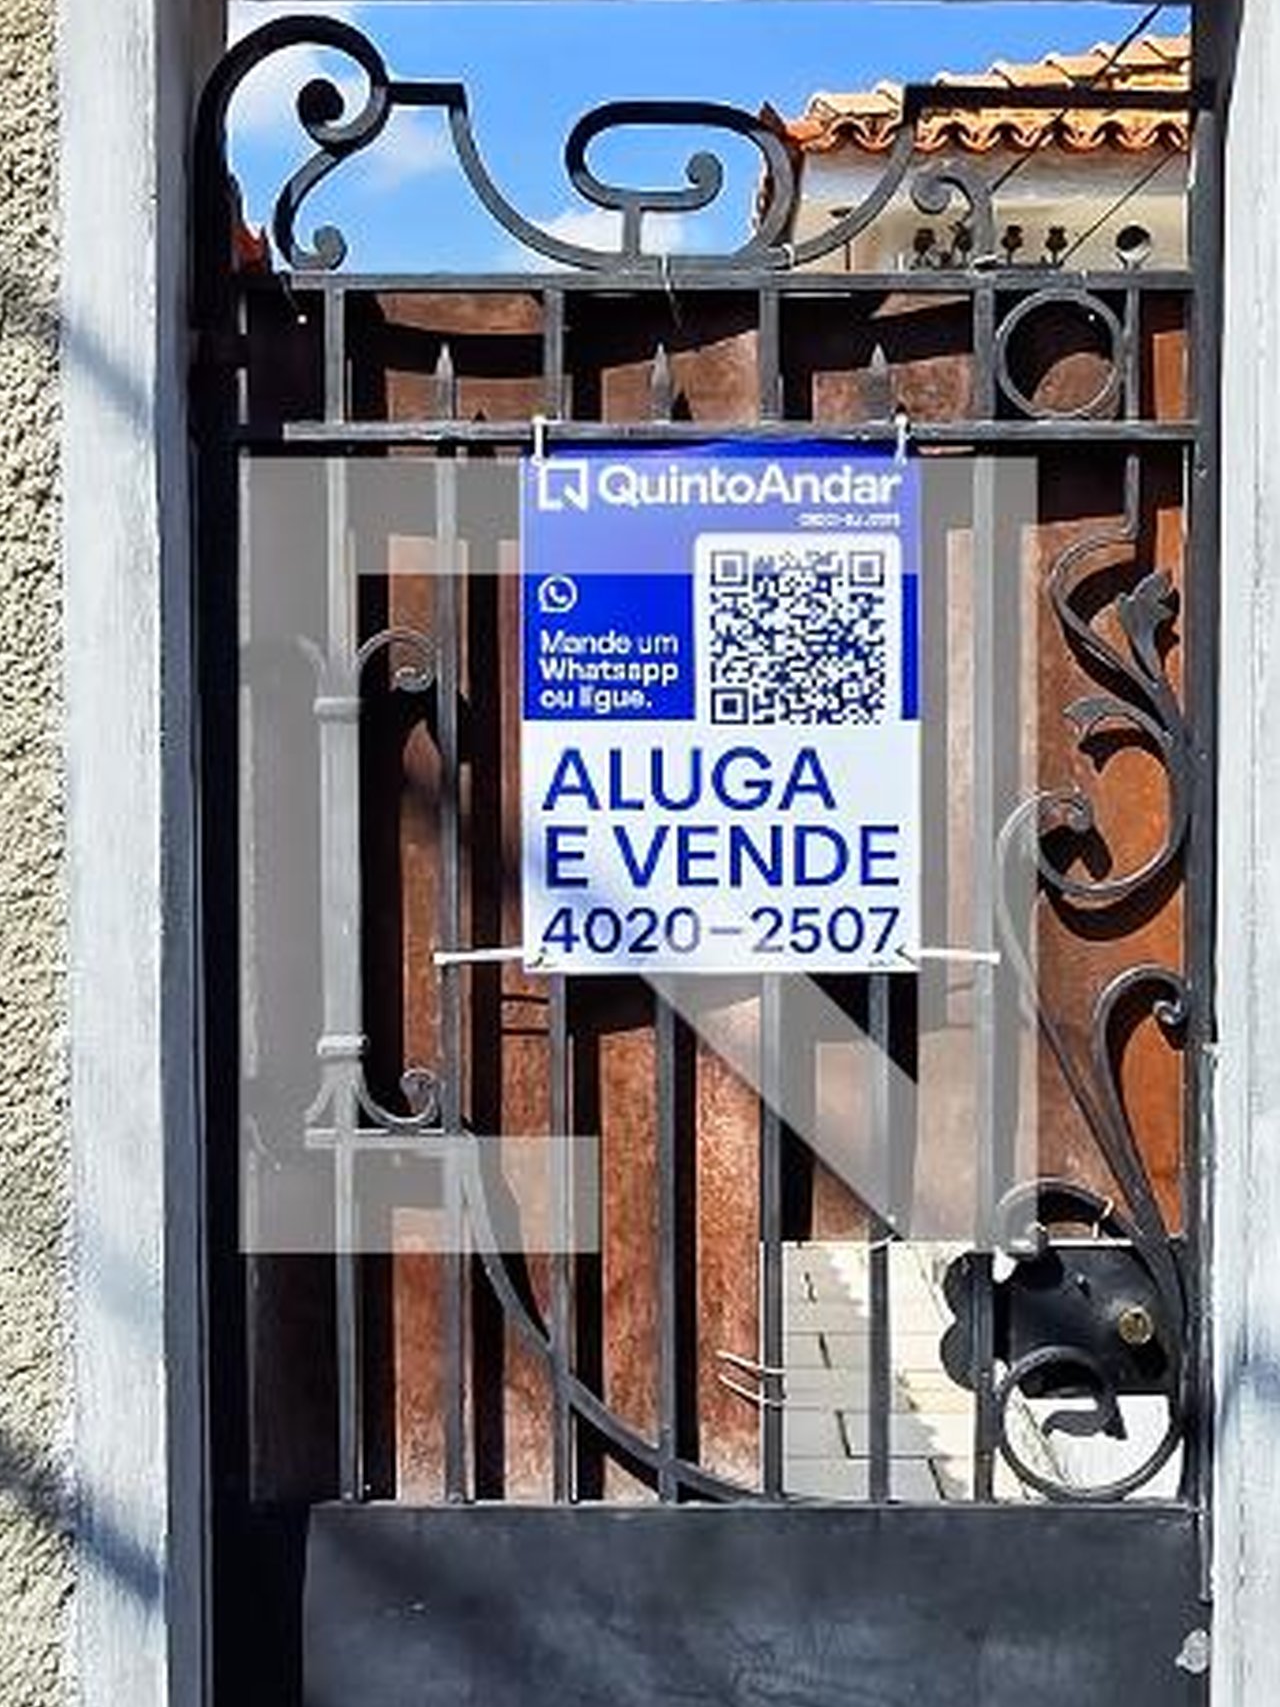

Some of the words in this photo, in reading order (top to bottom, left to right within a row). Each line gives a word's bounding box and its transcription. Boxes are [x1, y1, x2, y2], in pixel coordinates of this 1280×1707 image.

[598, 463, 902, 507] QuintoAndar
[540, 629, 631, 655] Mande
[638, 633, 679, 655] um
[538, 656, 679, 687] Whatsapp
[539, 689, 574, 709] ou
[579, 684, 653, 714] ligue.
[541, 747, 837, 811] ALUGA
[545, 825, 588, 888] E
[612, 825, 900, 888] VENDE
[541, 906, 901, 955] 4020-2507
